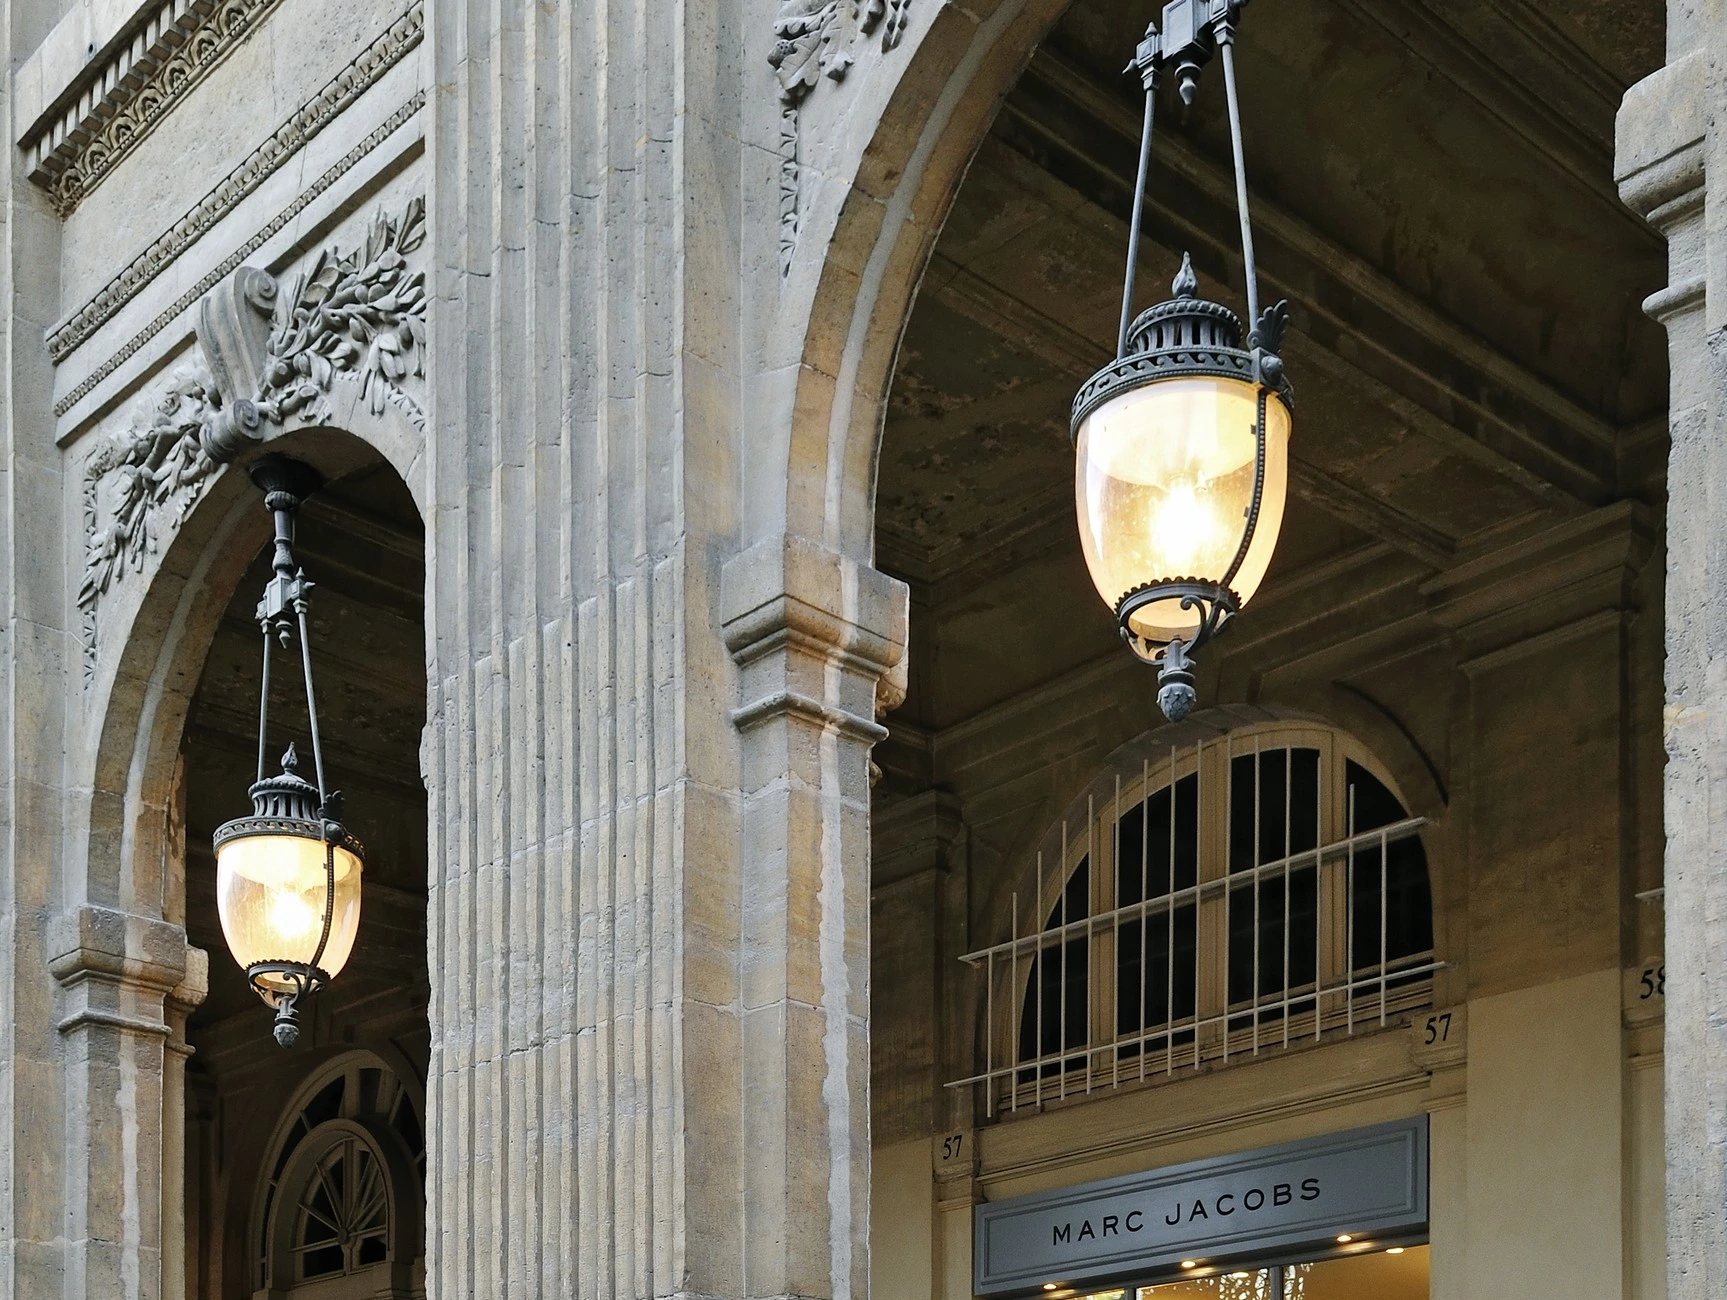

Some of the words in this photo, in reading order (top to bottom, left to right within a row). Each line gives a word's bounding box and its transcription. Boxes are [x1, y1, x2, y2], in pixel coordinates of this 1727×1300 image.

[1425, 1012, 1452, 1045] 57
[943, 1134, 963, 1160] 57
[1053, 1210, 1144, 1246] MARC
[1165, 1178, 1321, 1226] JACOBS
